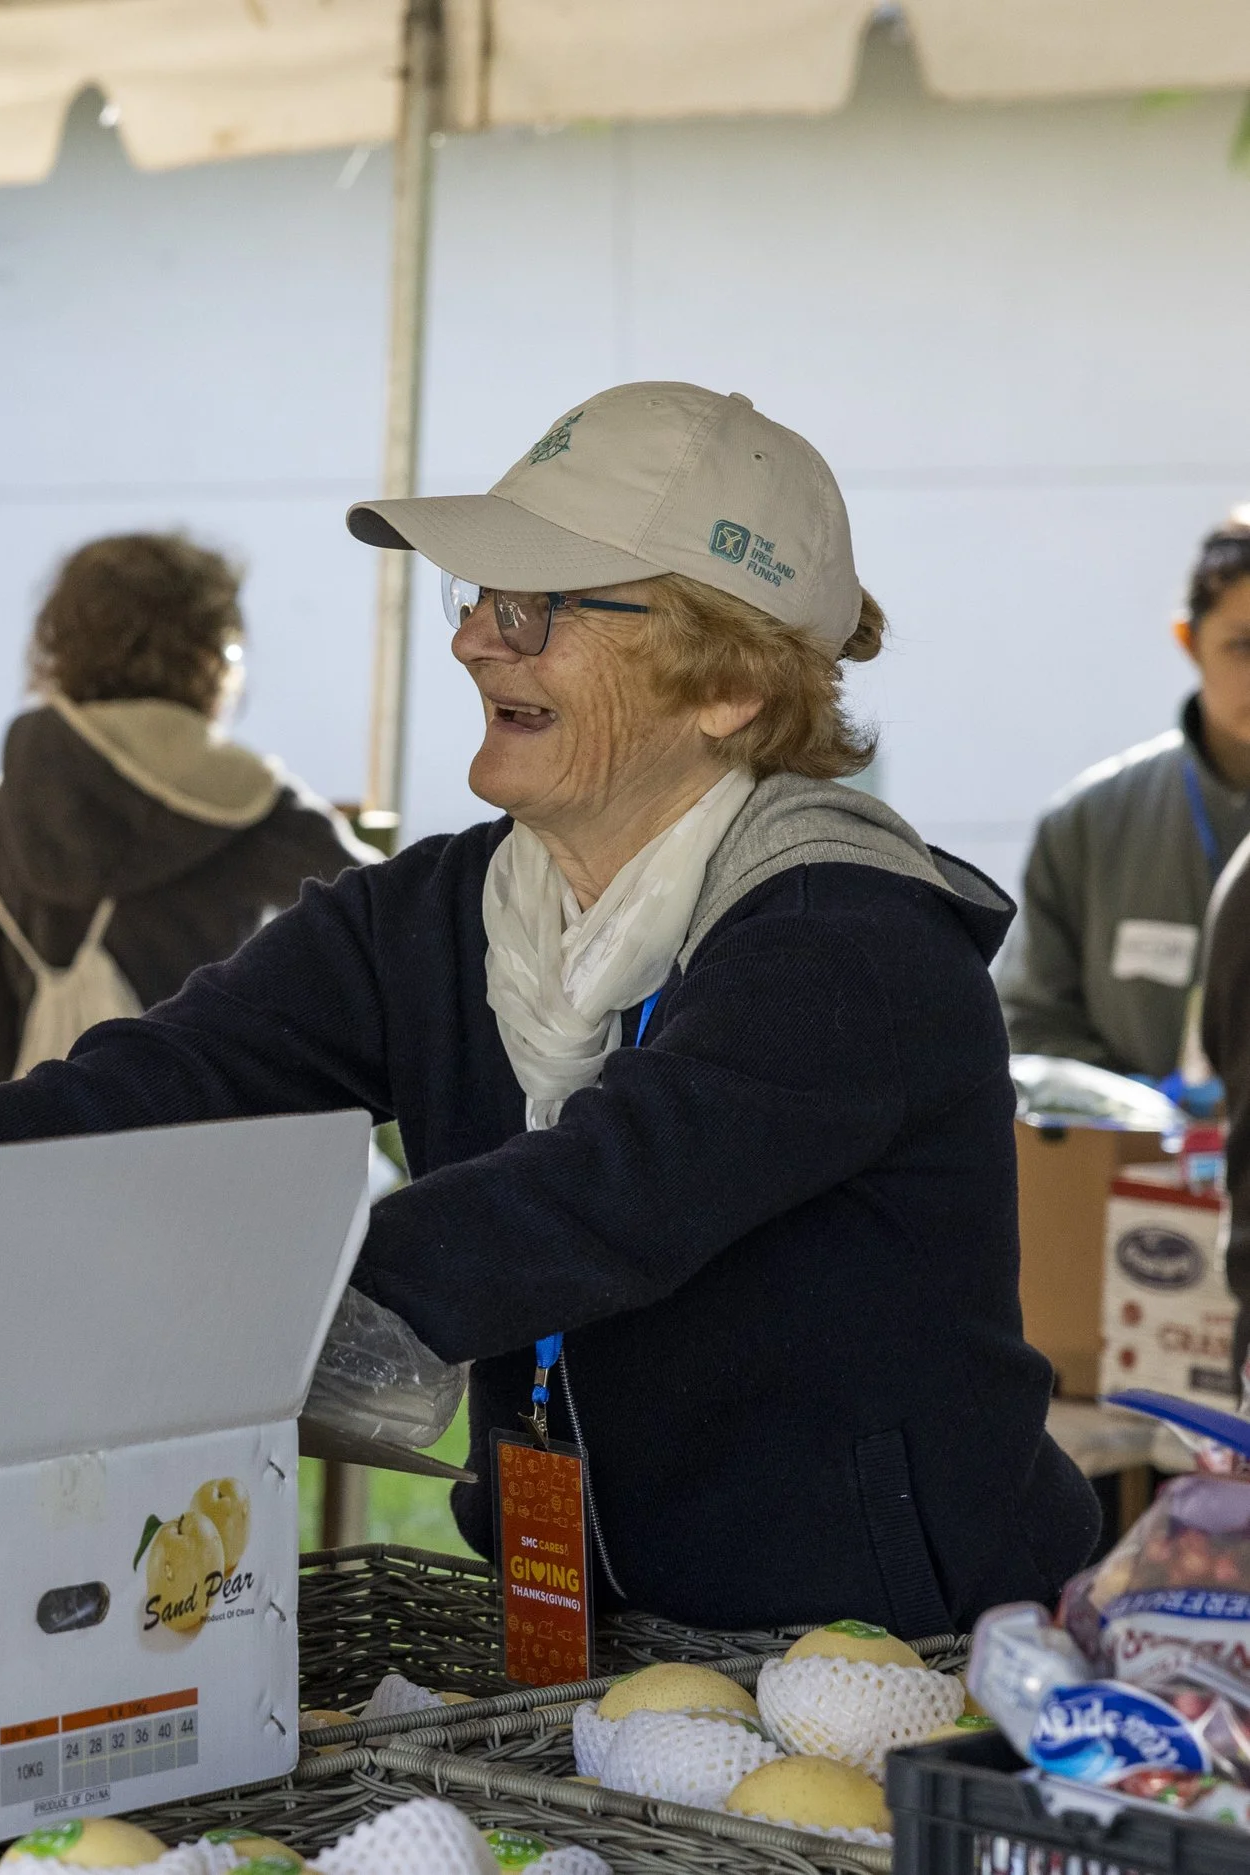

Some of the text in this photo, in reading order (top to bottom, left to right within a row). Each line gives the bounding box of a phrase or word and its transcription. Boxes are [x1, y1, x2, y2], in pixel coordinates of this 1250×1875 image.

[754, 534, 775, 554] THE
[747, 560, 781, 587] FUNDS
[750, 547, 796, 580] IRELAND
[521, 1536, 538, 1549] SMC
[143, 1570, 255, 1631] Sand Pear
[511, 1584, 581, 1612] THANKS(GIVING)
[236, 1608, 255, 1618] China
[66, 1718, 193, 1759] 24 28 32 36 40 44
[17, 1761, 44, 1780] 10KG
[34, 1788, 108, 1815] PRODUCE OF CHINA
